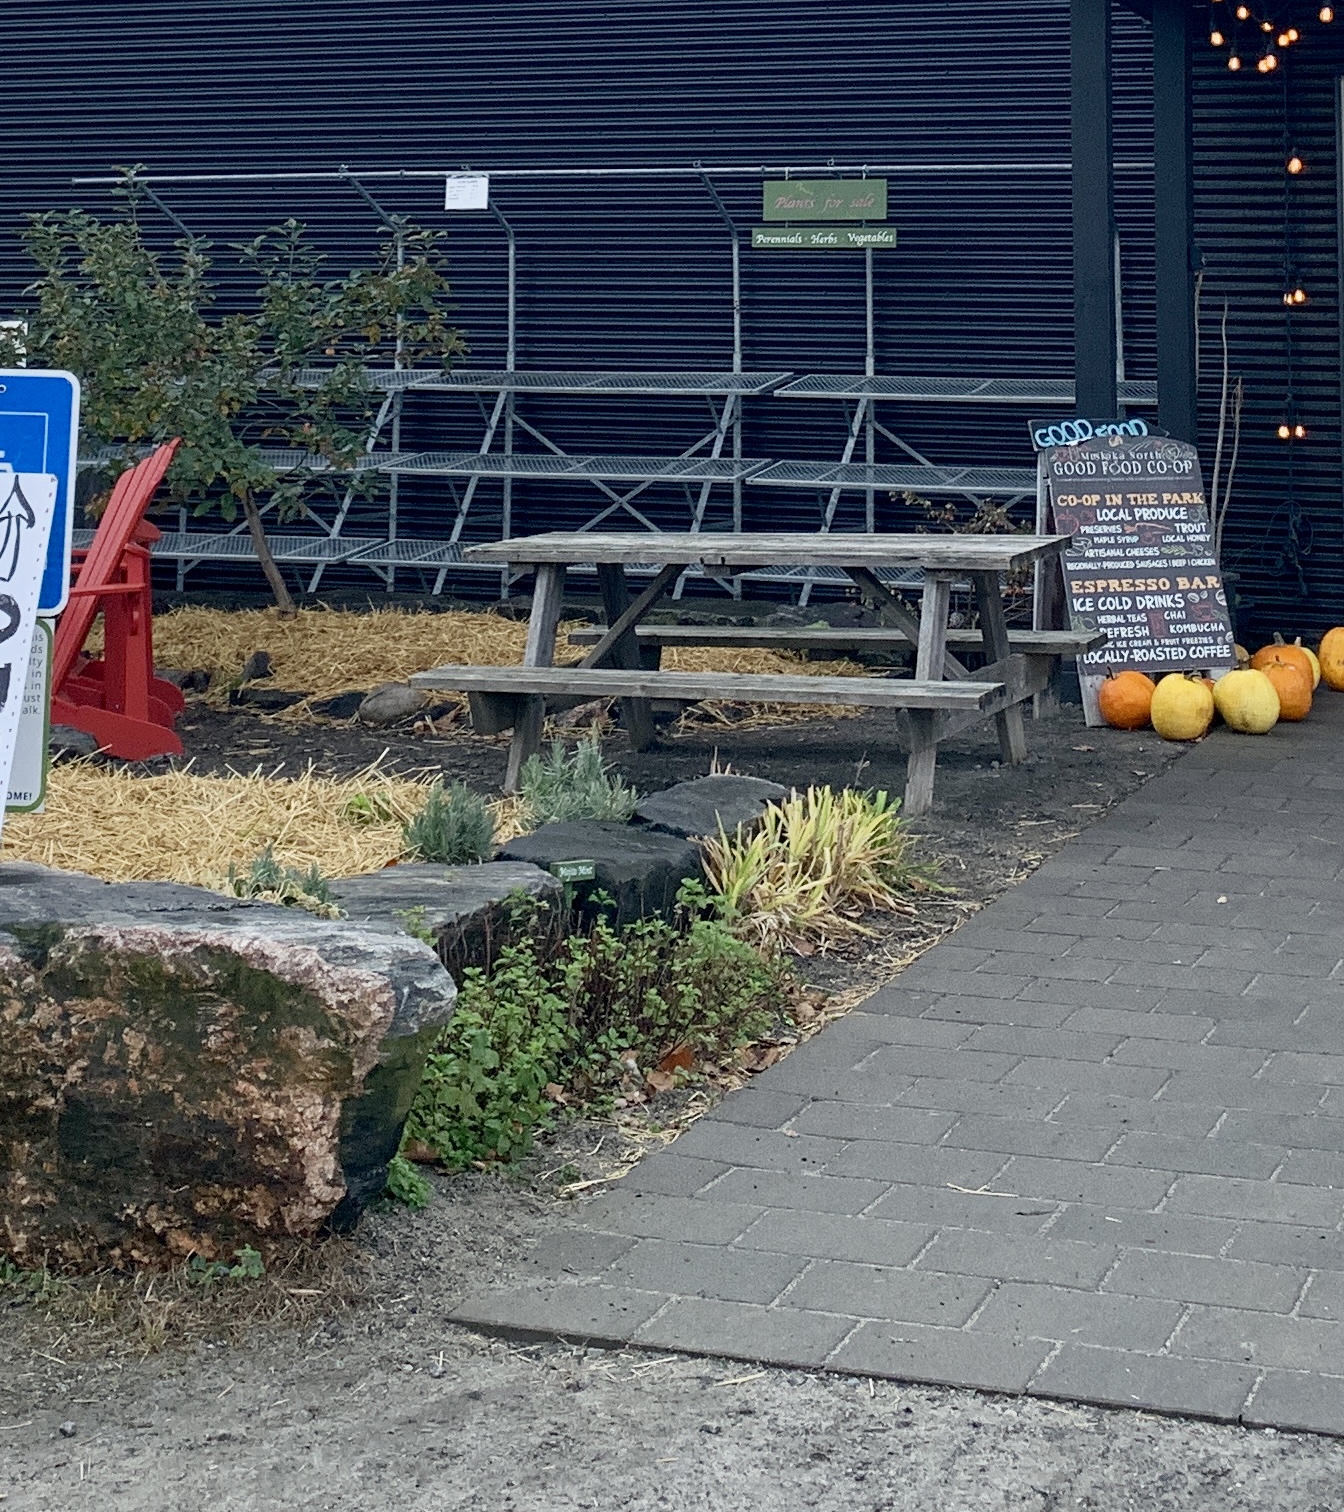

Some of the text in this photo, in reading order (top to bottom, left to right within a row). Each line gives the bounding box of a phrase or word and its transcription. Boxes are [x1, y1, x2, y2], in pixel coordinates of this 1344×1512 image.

[775, 193, 876, 214] Plants for sale
[756, 231, 893, 246] Perennials Herbs Vegetables
[1035, 419, 1093, 447] GOOD
[1081, 450, 1162, 461] Muskoka North
[1054, 461, 1097, 476] GOOD
[1147, 460, 1193, 475] CO-OP
[1057, 492, 1204, 507] CO-OP IN THE PARK
[1096, 507, 1188, 522] LOCAL PRODUCE
[1080, 523, 1207, 534] PRESERVES TROUT
[1094, 534, 1211, 544] MAPLE SYRUP LOCAL HONEY
[1084, 547, 1161, 558] ARTISANAL CHEESES
[1136, 559, 1168, 569] SAUSAGES
[1070, 575, 1221, 594] ESPRESSO BAR
[1072, 593, 1185, 612] ICE COLD DRINKS
[1097, 611, 1186, 624] HERBAL TEAS CHAI
[1169, 622, 1225, 634] KOMBUCHA
[1116, 640, 1127, 648] ICE
[1129, 639, 1153, 647] CREAM
[1161, 637, 1180, 645] FRUIT
[1083, 645, 1232, 664] LOCALLY-ROASTED COFFEE
